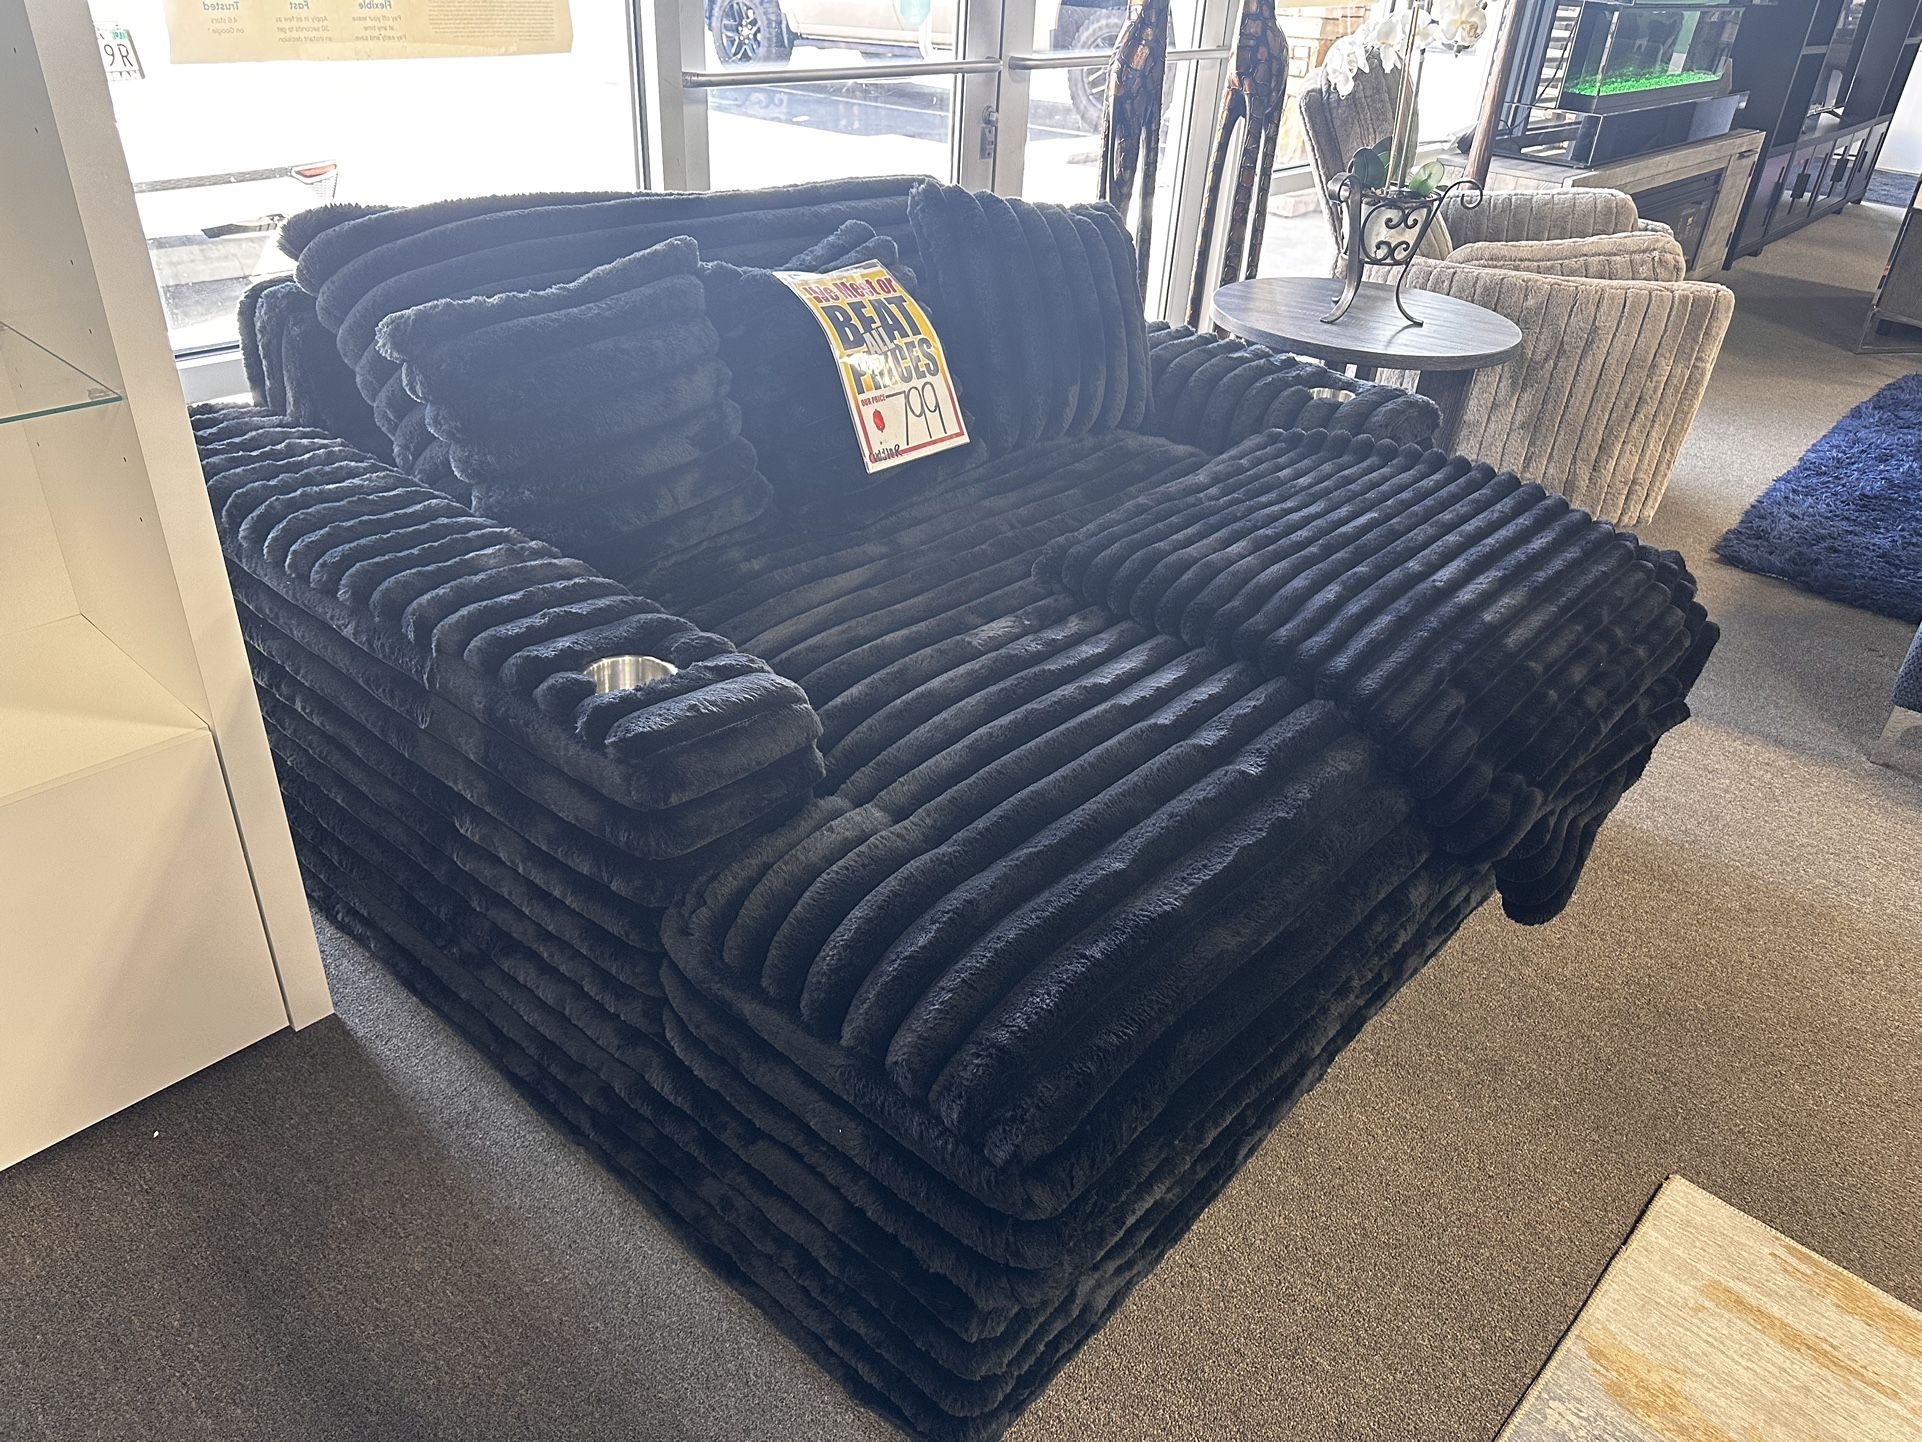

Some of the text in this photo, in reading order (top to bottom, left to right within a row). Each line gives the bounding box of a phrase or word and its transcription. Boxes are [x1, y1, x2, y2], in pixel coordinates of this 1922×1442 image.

[832, 279, 881, 300] Meet
[876, 277, 898, 295] or
[820, 295, 922, 351] BEAT
[862, 326, 896, 355] ALL
[861, 393, 887, 407] OUR PRICE
[885, 381, 948, 446] 799
